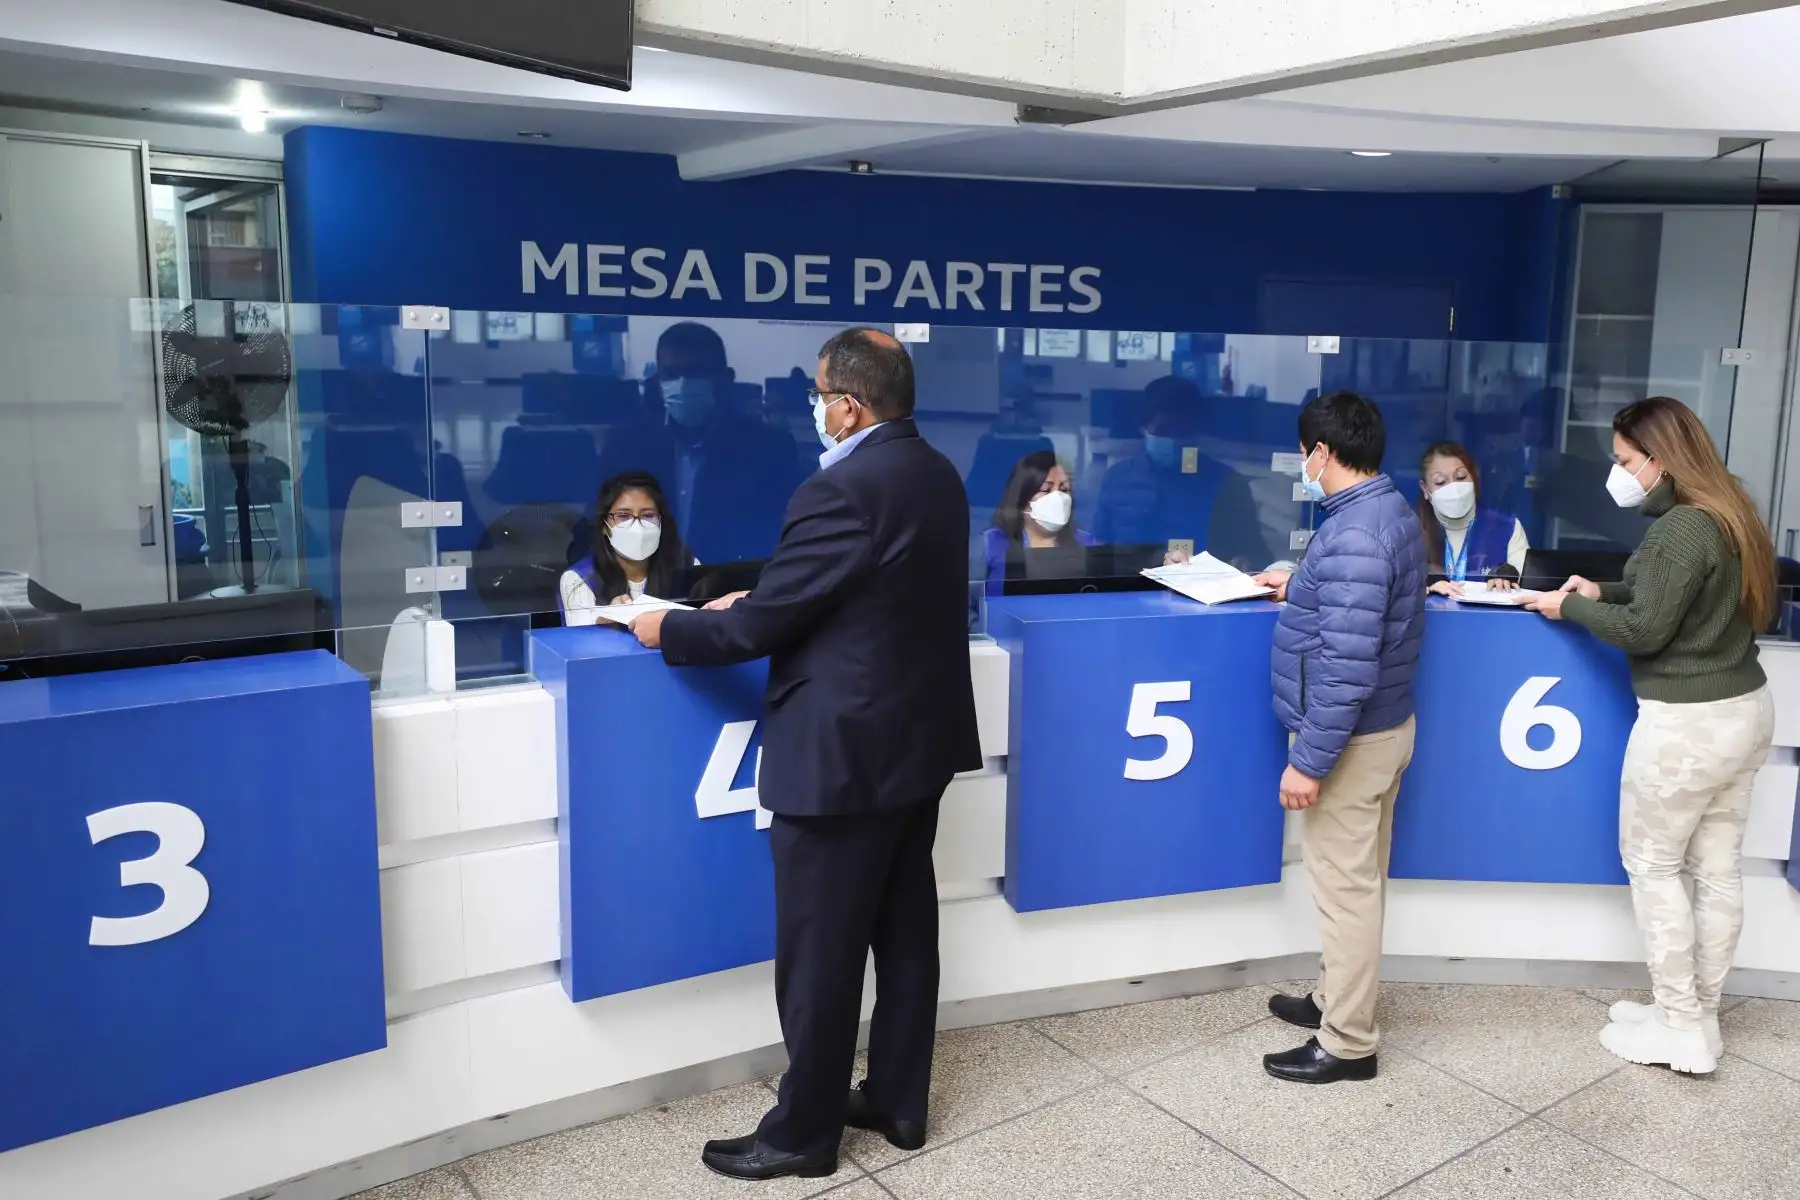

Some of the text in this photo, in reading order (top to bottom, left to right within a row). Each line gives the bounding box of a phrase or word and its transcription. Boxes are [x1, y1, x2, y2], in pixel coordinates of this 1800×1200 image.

[521, 240, 1102, 314] MESA DE PARTES
[1123, 680, 1194, 781] 5
[1499, 675, 1582, 771] 6
[694, 719, 775, 830] 4
[85, 801, 210, 947] 3
